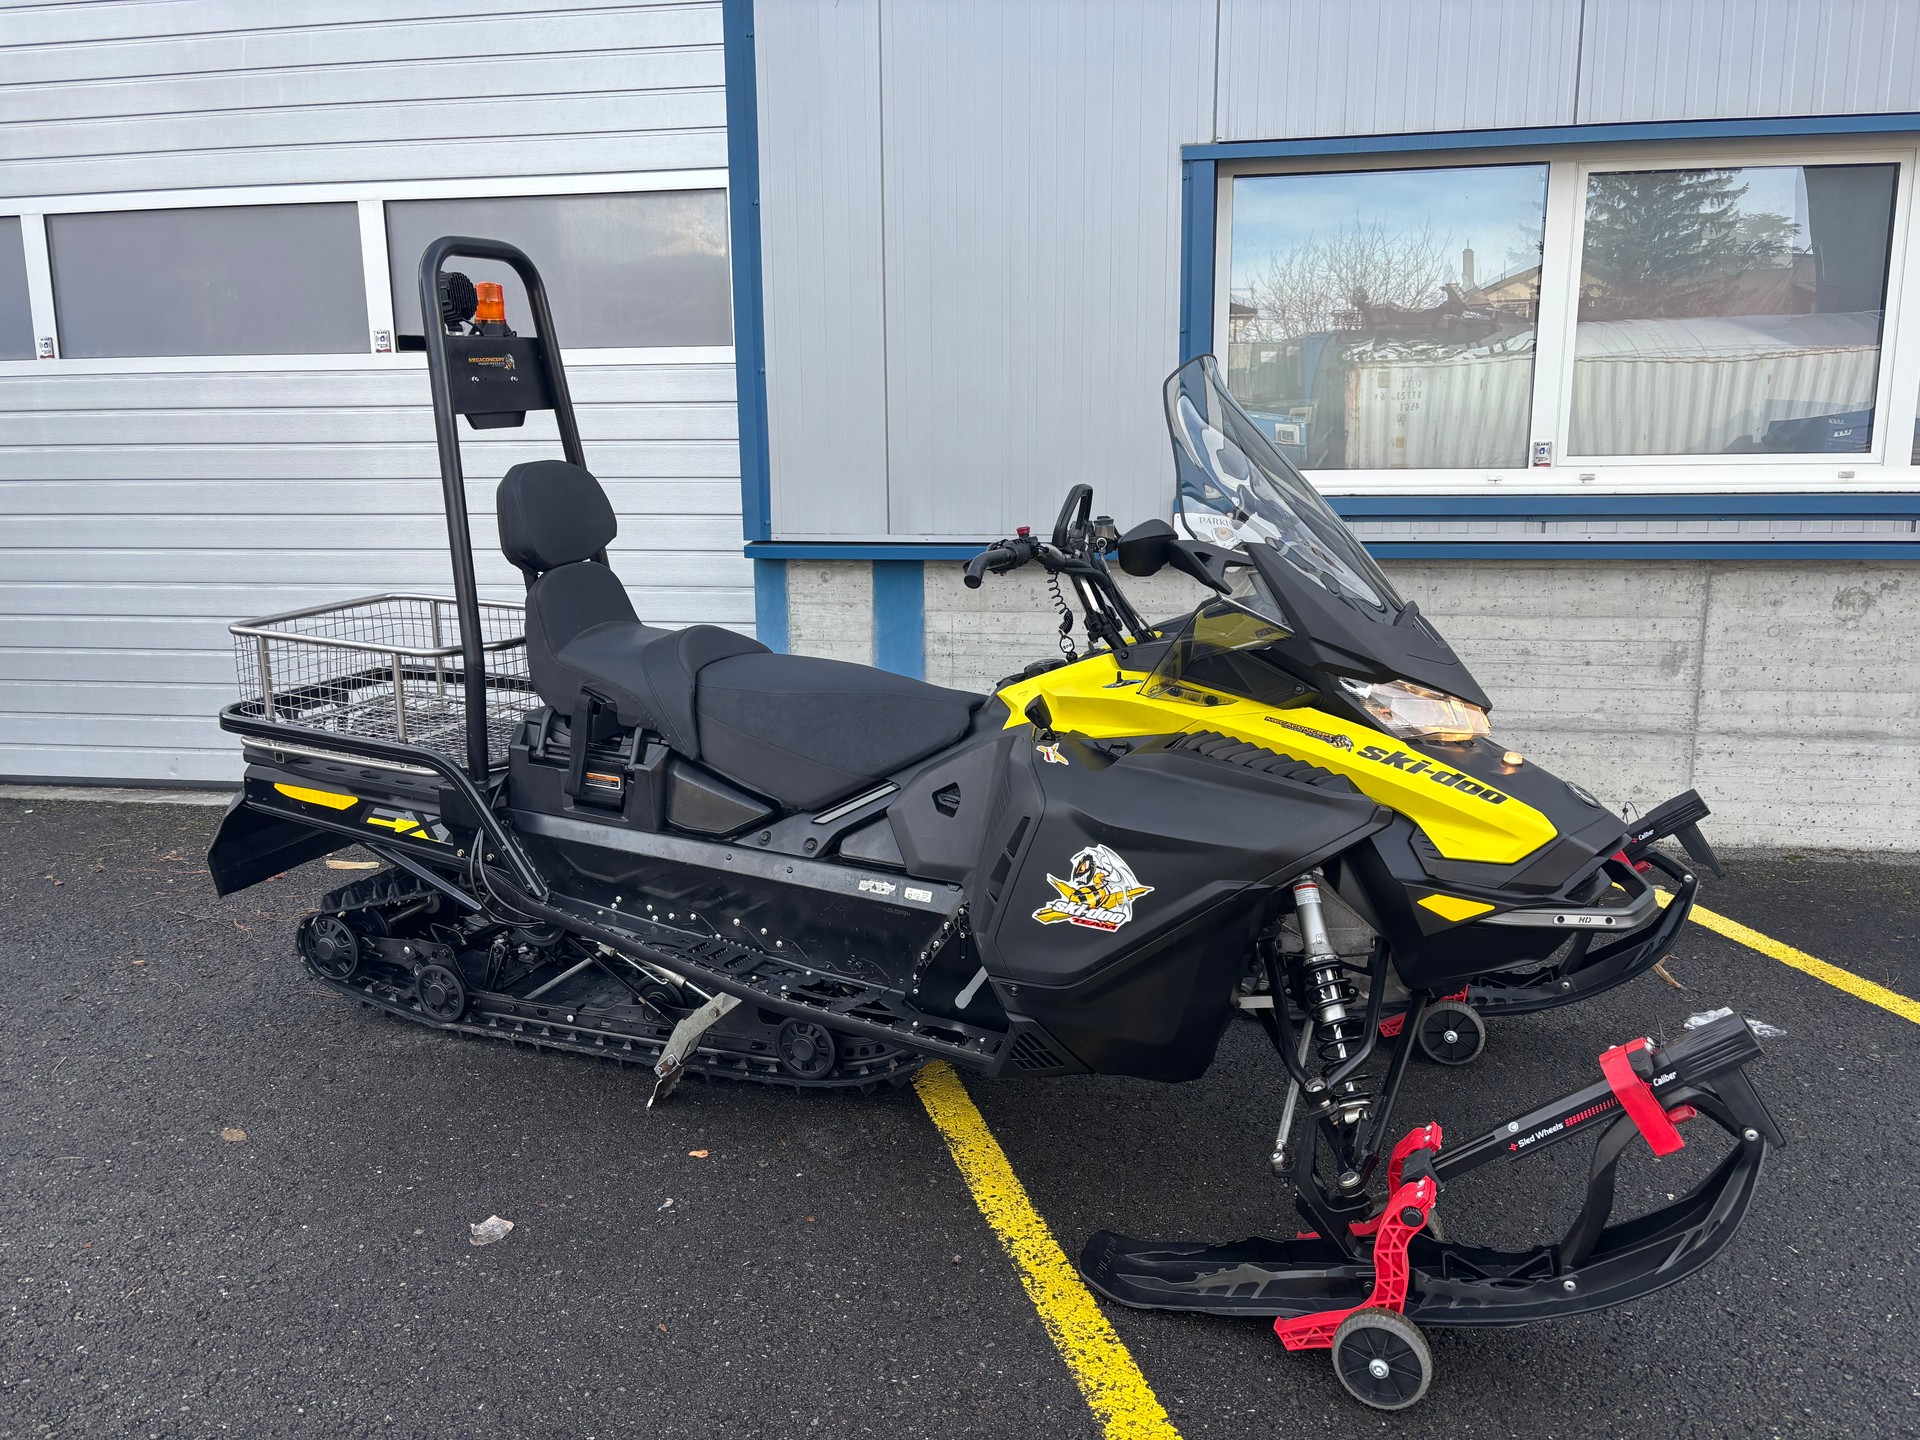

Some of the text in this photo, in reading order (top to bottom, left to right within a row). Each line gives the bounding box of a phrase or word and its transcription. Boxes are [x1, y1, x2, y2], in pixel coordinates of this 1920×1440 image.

[1266, 716, 1333, 738] MEGACONCEPT
[1072, 917, 1118, 930] TEAM
[1578, 916, 1592, 924] HD
[1652, 1070, 1677, 1087] Caliber
[1517, 1122, 1564, 1148] Sled Wheels
